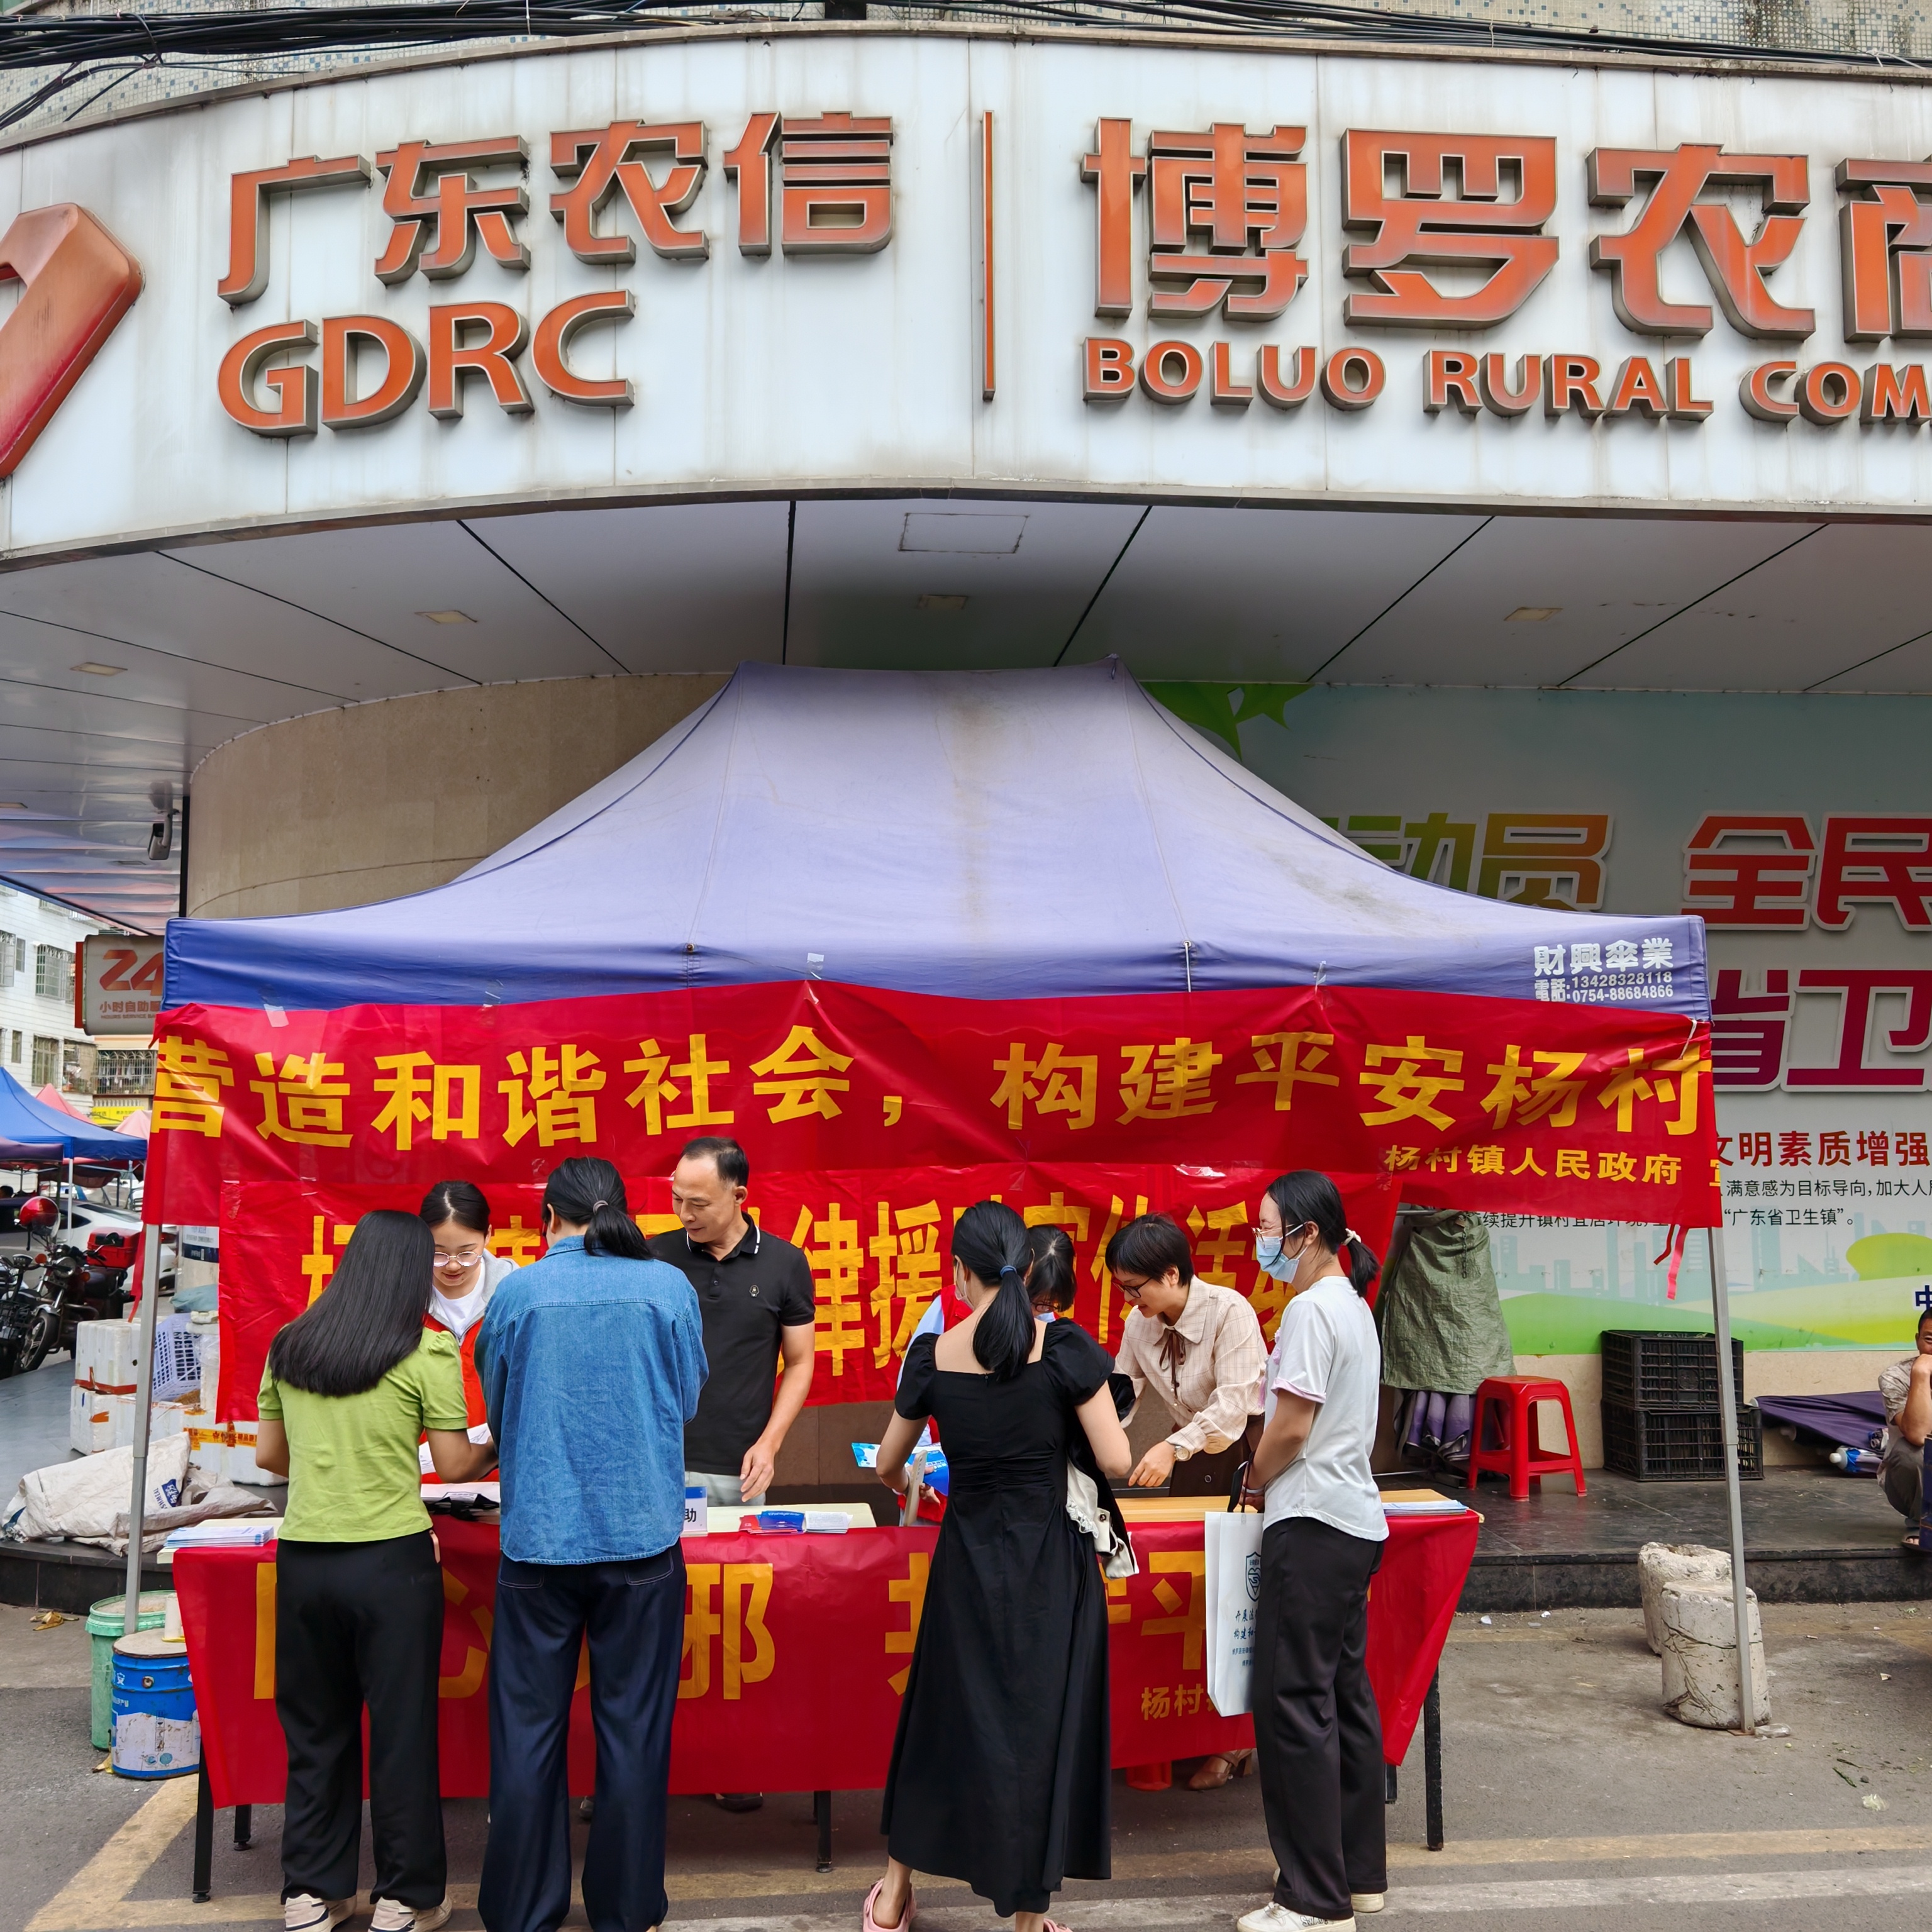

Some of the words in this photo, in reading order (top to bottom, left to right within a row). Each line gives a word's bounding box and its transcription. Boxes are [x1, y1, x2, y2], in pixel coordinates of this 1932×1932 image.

[218, 111, 893, 306] 广东农信
[216, 289, 635, 436] GDRC
[1082, 337, 1386, 412] BOLUO
[1423, 348, 1714, 422] RURAL
[1738, 360, 1932, 426] COM
[1321, 813, 1608, 911] 动员
[1681, 816, 1932, 926] 全民
[99, 950, 164, 996] 24
[1533, 937, 1674, 977] 財興傘業
[1572, 971, 1673, 989] 13428328118
[1572, 984, 1674, 1003] 0754-88684866
[1384, 1143, 1682, 1186] 杨村镇人民政府
[1233, 1626, 1257, 1640] 构建和
